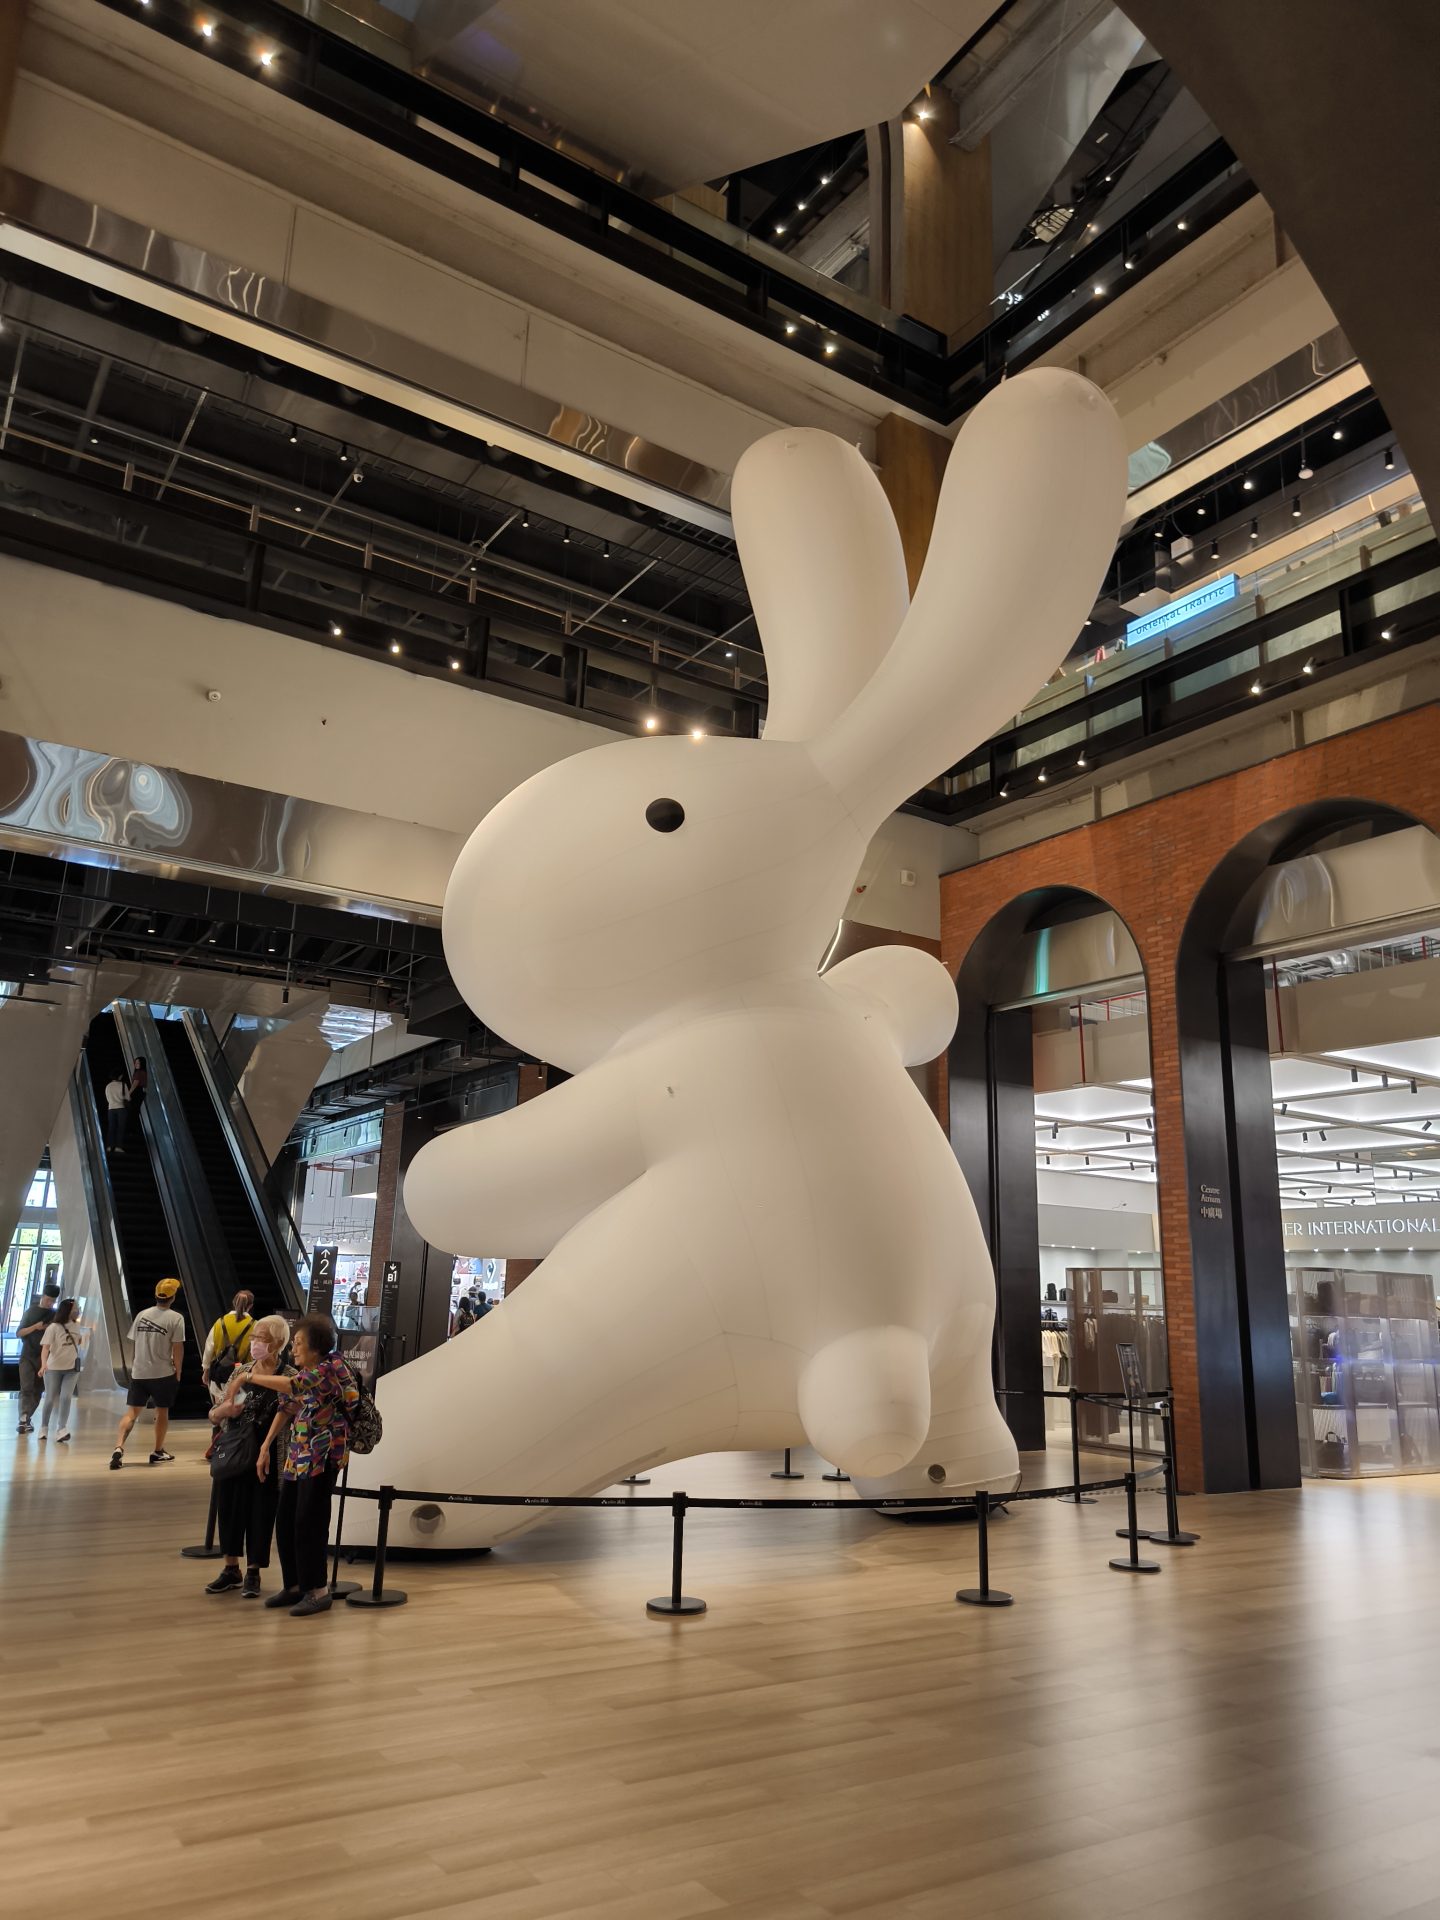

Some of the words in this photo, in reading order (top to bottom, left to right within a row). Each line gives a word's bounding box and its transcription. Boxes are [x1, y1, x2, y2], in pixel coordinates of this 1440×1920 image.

[1200, 1193, 1221, 1203] Atrium
[1283, 1222, 1303, 1236] ER
[1308, 1217, 1440, 1236] INTERNATIONAL
[319, 1259, 329, 1275] 2
[387, 1270, 398, 1282] B1
